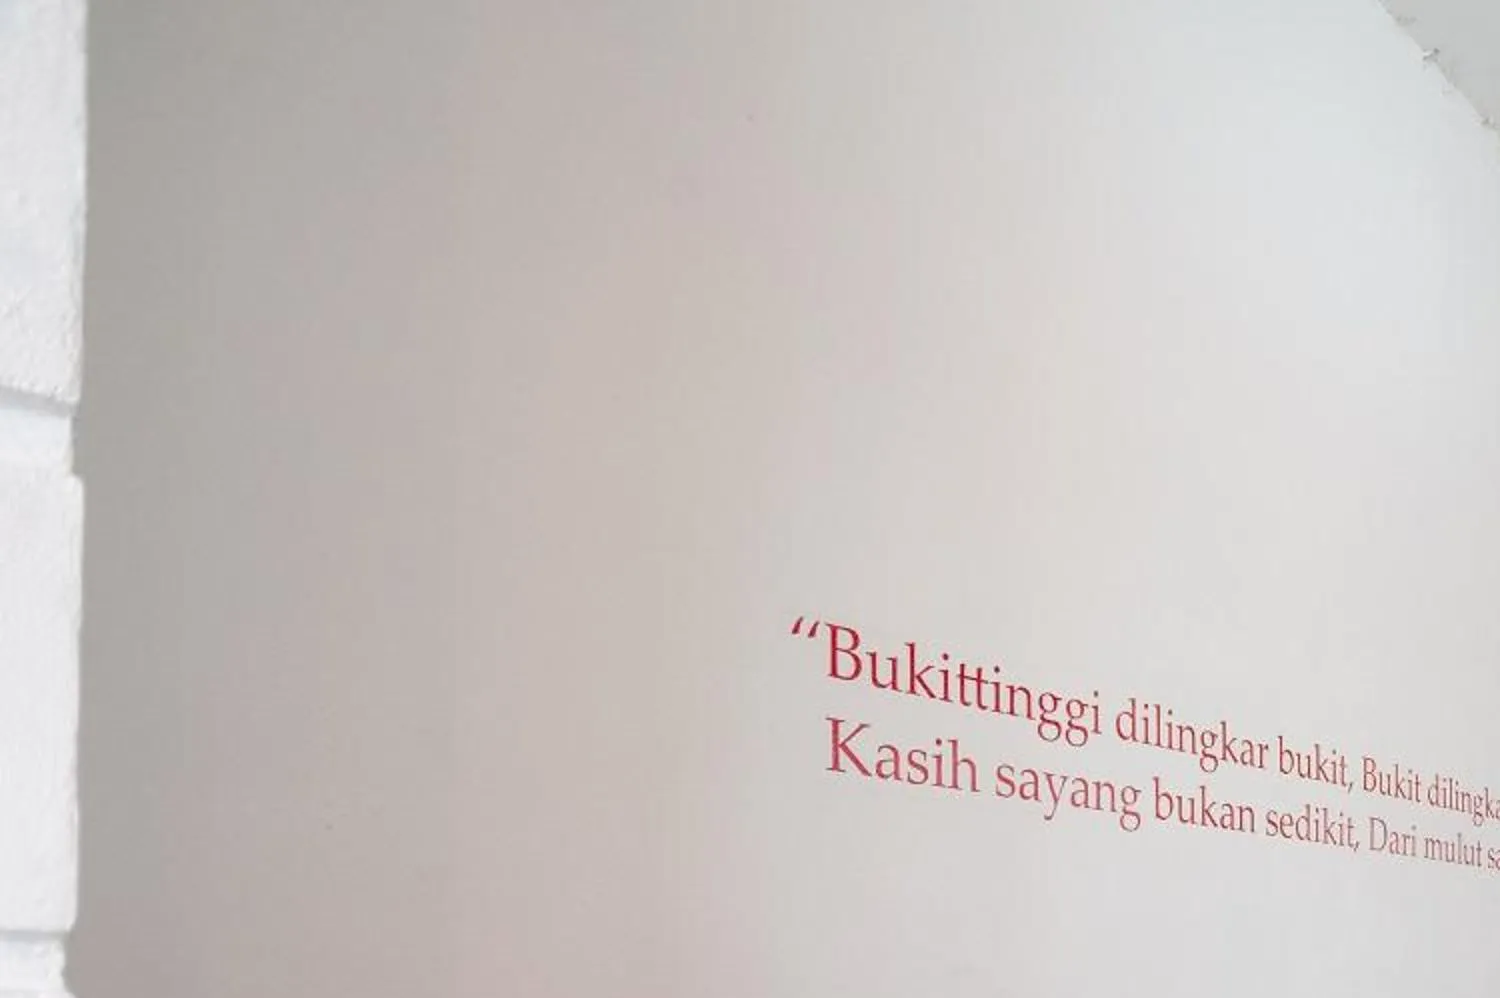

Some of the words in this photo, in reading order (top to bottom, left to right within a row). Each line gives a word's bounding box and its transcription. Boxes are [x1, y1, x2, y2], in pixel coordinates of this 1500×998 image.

[790, 615, 1103, 748] “Bukittinggi
[1114, 696, 1270, 774] dilingkar
[1276, 733, 1355, 794] bukit,
[1361, 755, 1422, 804] Bukit
[824, 716, 981, 793] Kasih
[994, 762, 1143, 833] sayang
[1151, 775, 1256, 834] bukan
[1264, 803, 1361, 853] sedikit,
[1368, 816, 1417, 858] Dari
[1423, 832, 1483, 868] mulut
